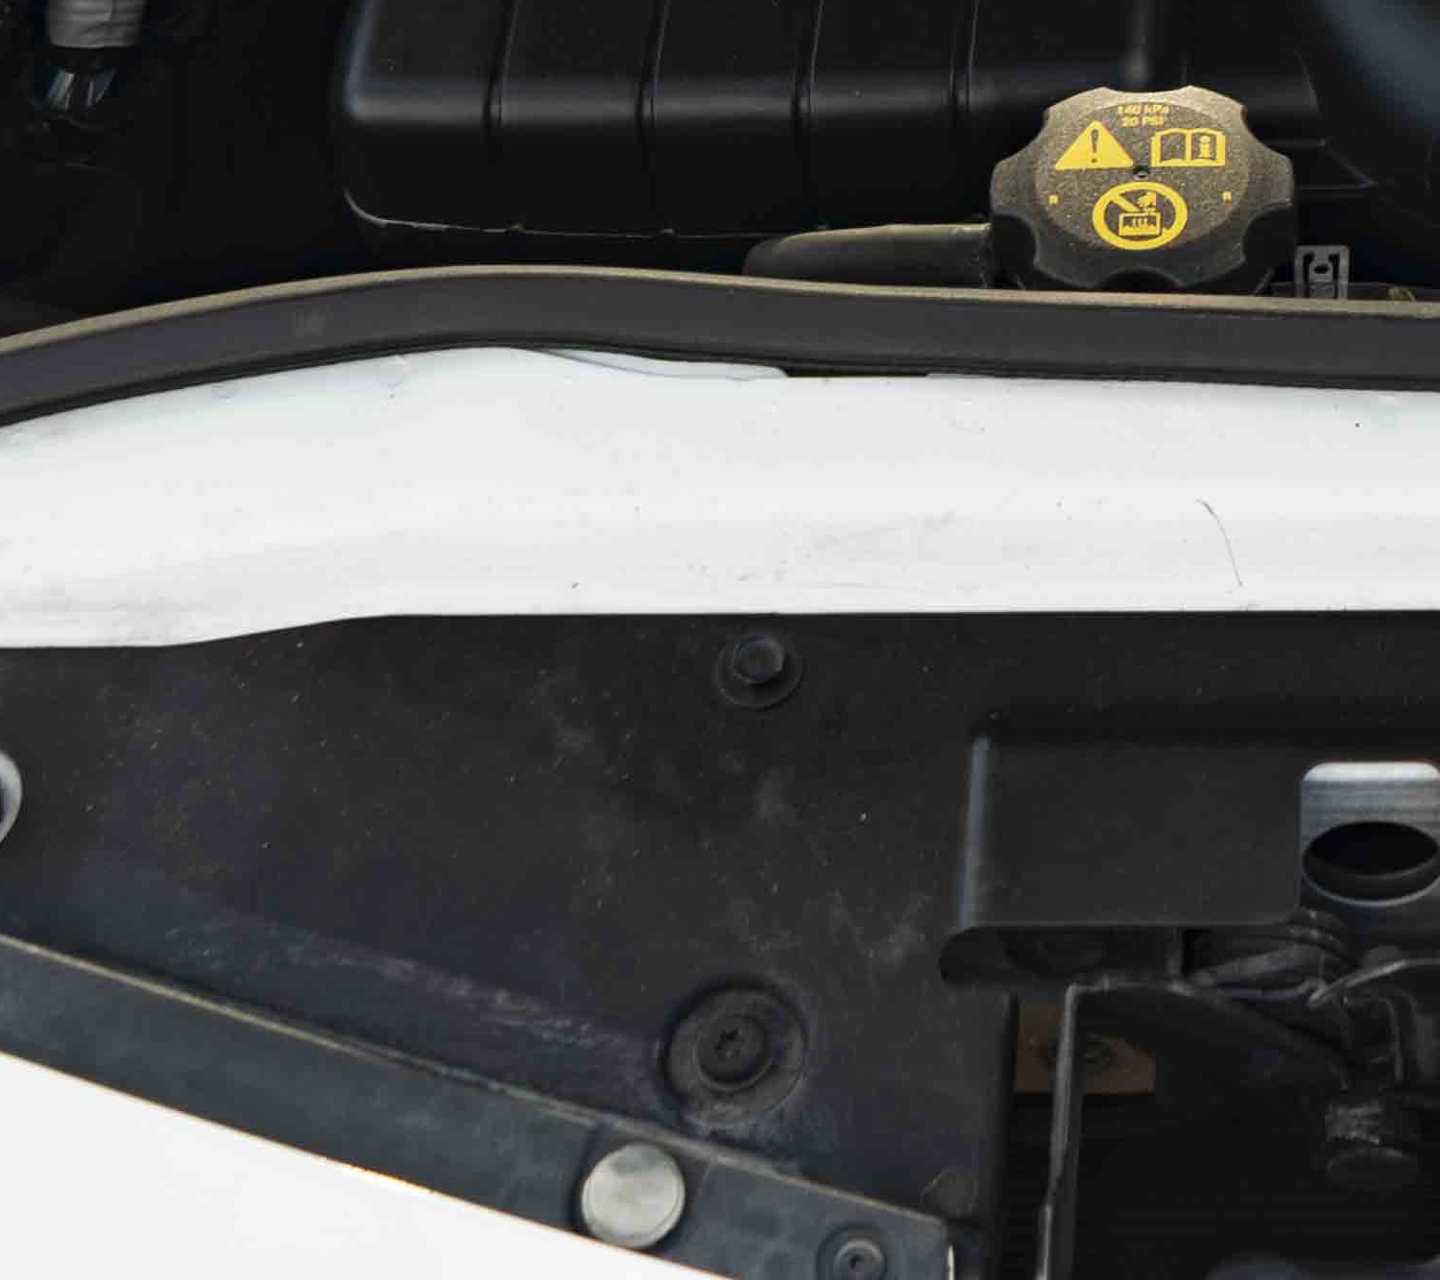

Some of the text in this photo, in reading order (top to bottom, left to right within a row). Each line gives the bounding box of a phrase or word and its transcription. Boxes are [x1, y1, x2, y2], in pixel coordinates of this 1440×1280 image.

[1143, 104, 1169, 114] kPa
[1120, 116, 1165, 127] 20 PSI
